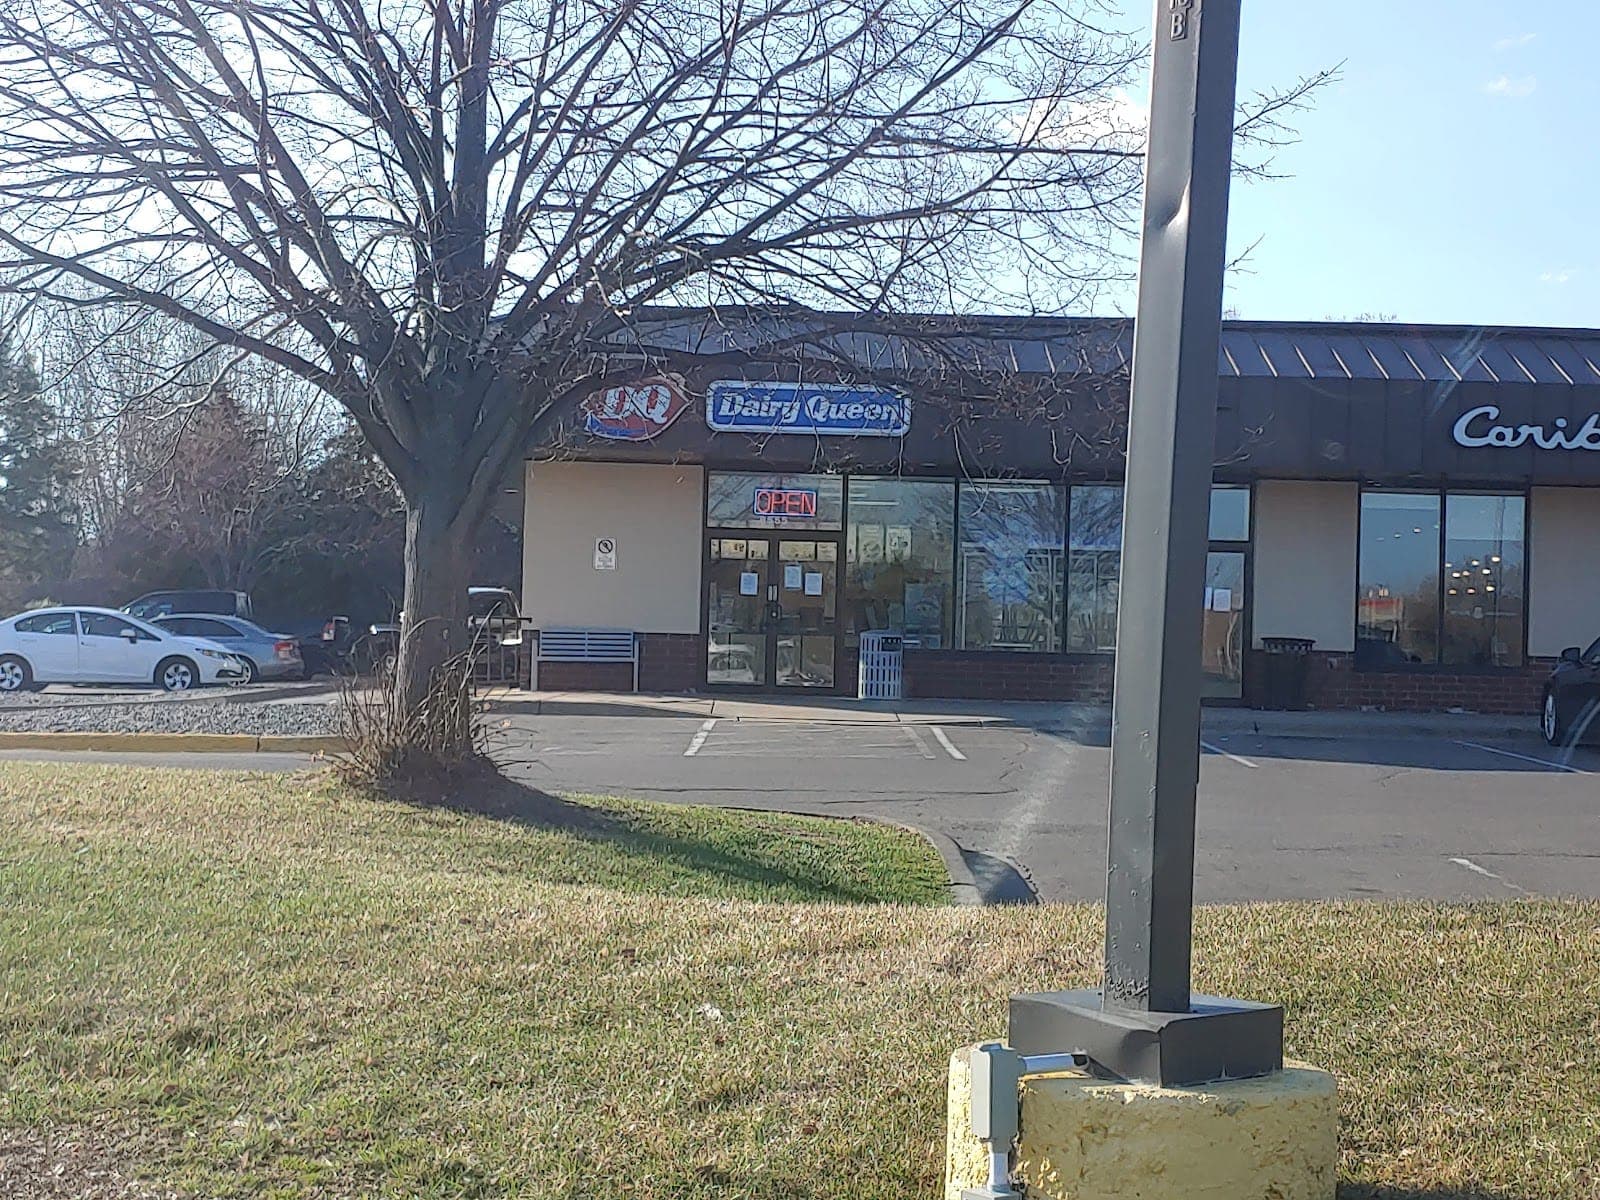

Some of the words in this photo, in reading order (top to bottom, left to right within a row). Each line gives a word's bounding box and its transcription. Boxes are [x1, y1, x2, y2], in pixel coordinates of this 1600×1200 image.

[1170, 12, 1184, 39] B
[597, 384, 672, 424] DQ
[718, 392, 800, 424] Dairy
[804, 395, 900, 423] Queen
[757, 490, 816, 515] OPEN
